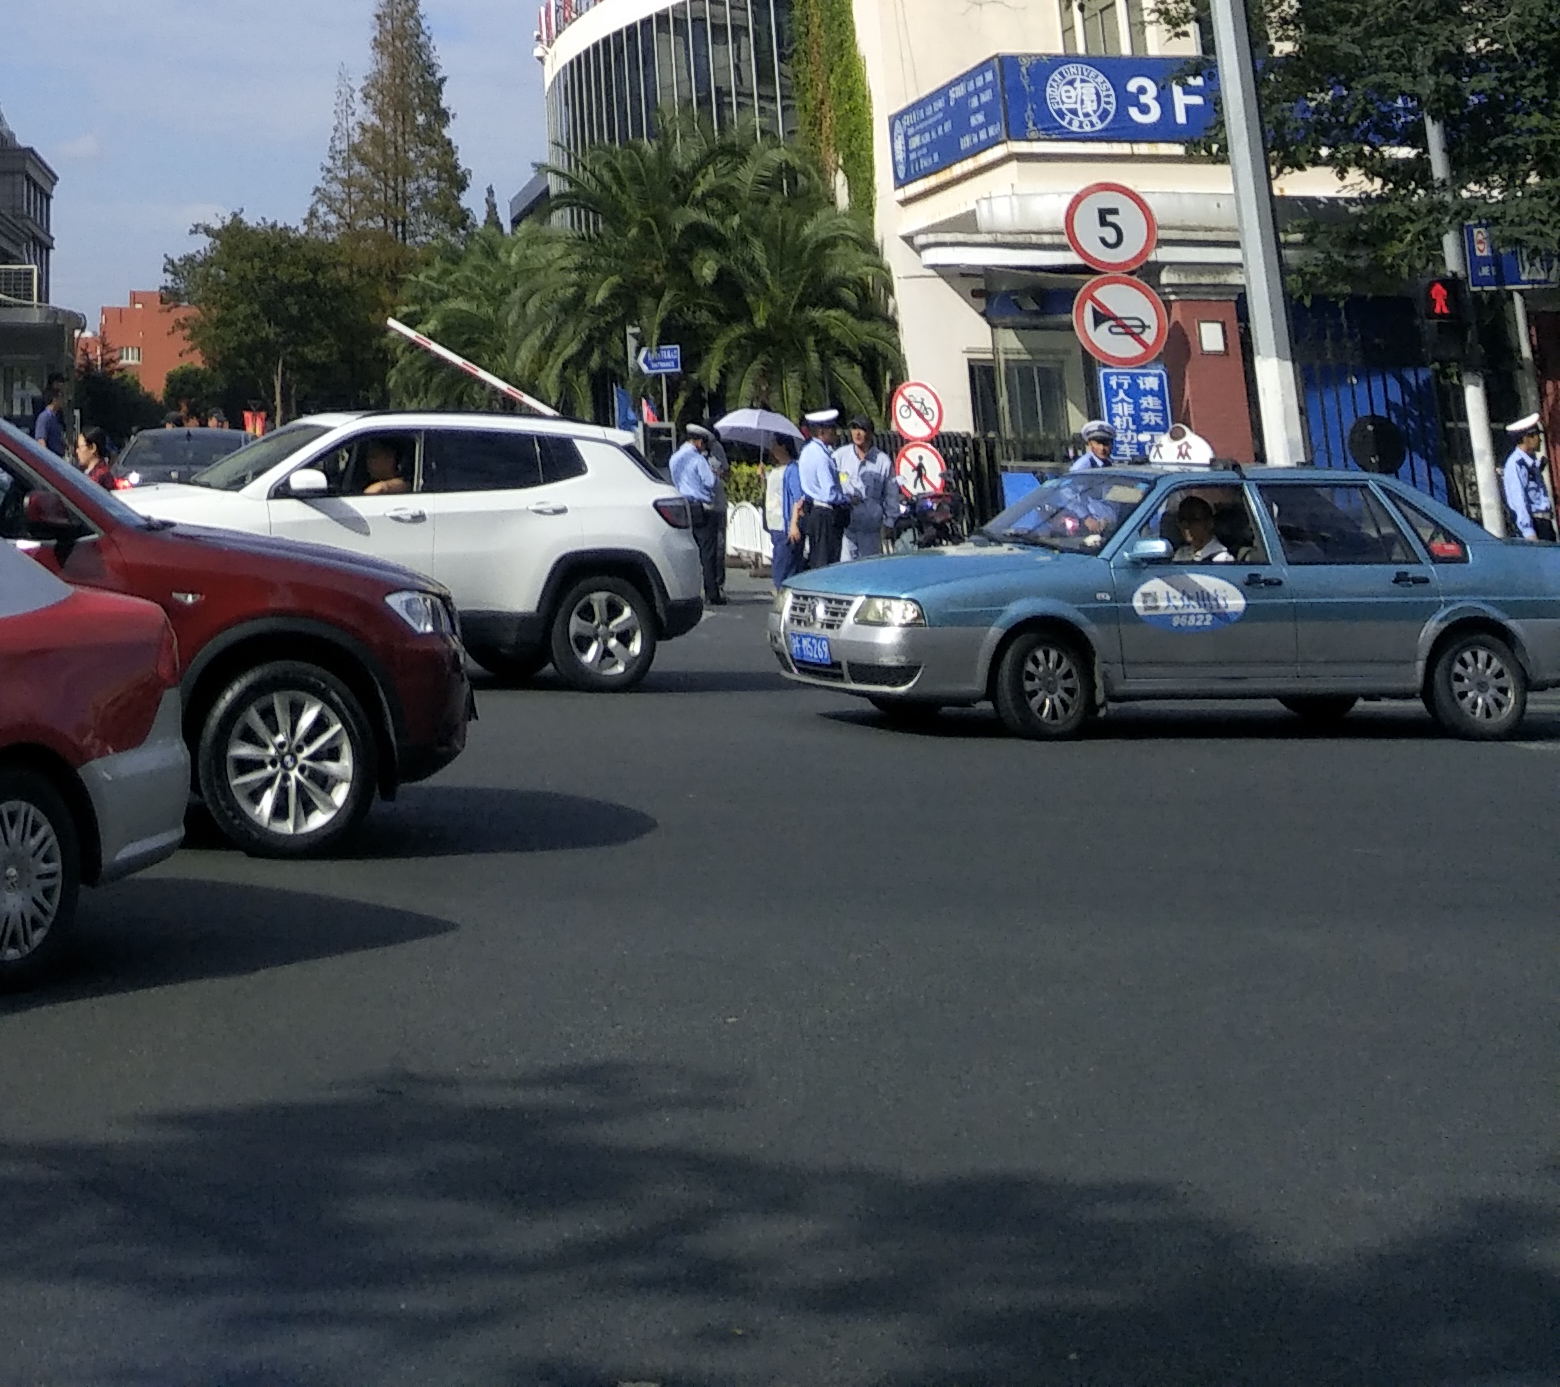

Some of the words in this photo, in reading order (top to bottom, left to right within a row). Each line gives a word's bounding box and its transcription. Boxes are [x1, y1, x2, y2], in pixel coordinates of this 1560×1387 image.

[1097, 207, 1124, 249] 5
[1109, 375, 1140, 457] 行人非机动车
